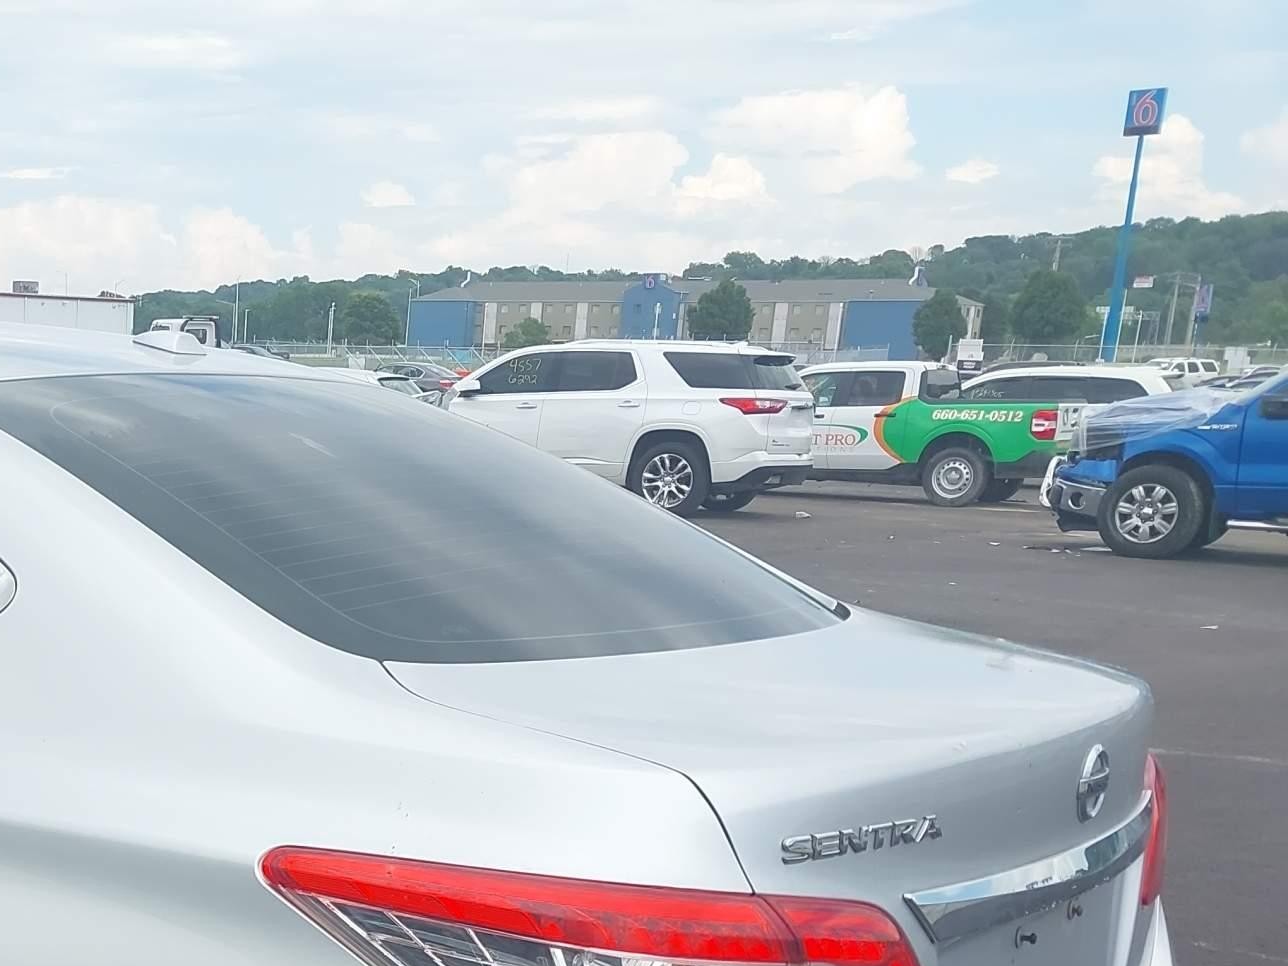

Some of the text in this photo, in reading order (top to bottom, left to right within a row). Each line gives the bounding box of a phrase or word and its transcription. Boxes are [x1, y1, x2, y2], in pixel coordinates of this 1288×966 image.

[1133, 90, 1158, 127] 6
[509, 359, 542, 373] 4557
[932, 408, 1024, 422] 660-651-0512
[824, 433, 856, 446] PRO
[781, 814, 943, 865] SENTRA
